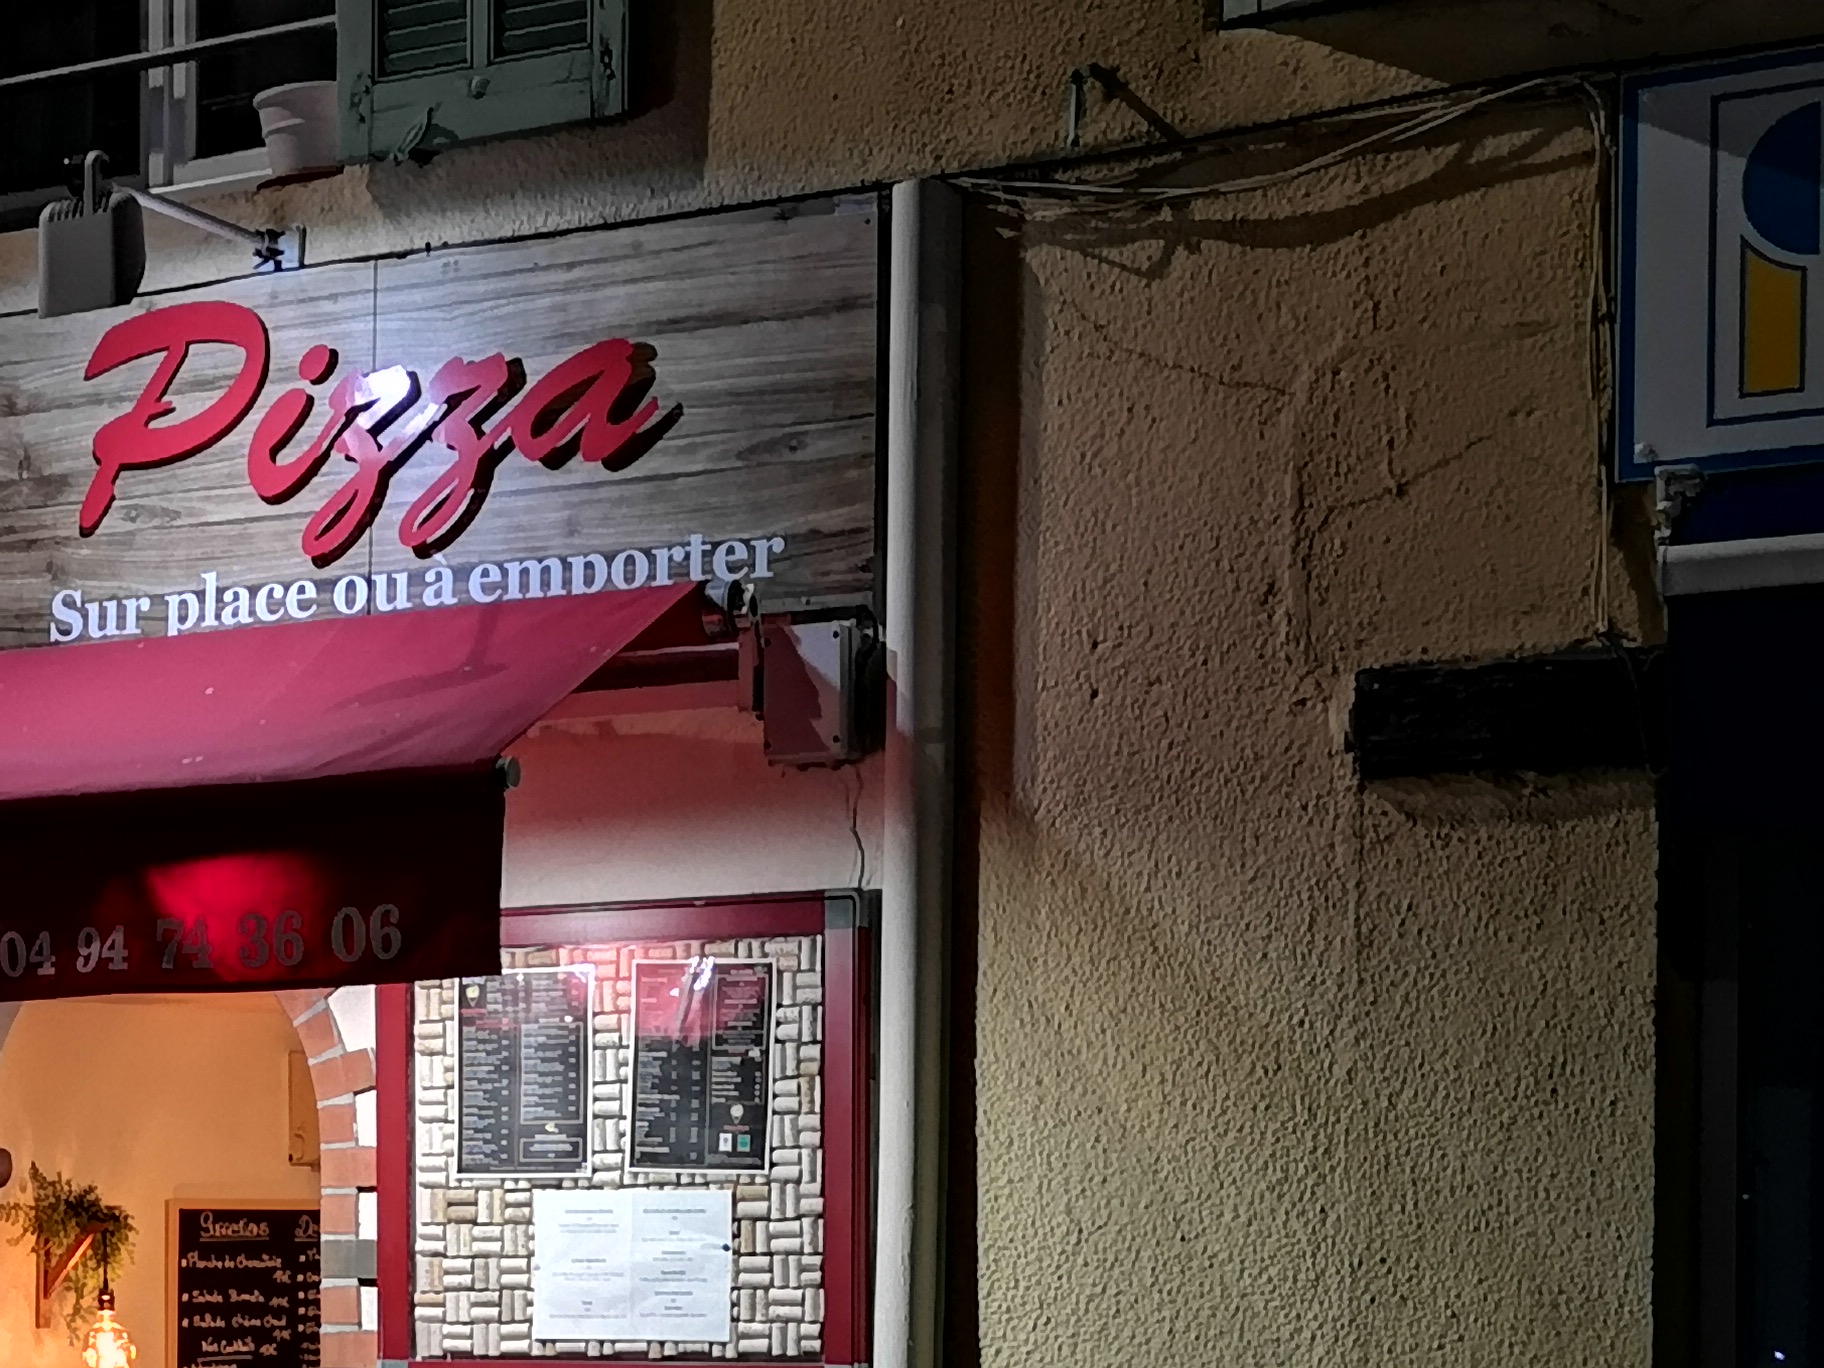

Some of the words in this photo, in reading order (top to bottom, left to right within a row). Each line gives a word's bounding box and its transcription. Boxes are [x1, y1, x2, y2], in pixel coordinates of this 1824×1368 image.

[80, 300, 672, 562] Pizza
[49, 590, 151, 643] Sur
[166, 570, 318, 634] place
[333, 575, 414, 615] ou
[423, 555, 455, 606] à
[467, 533, 786, 600] emporter
[0, 930, 56, 978] 04
[76, 925, 129, 973] 94
[156, 915, 214, 969] 74
[238, 909, 305, 968] 36
[331, 903, 402, 962] 06
